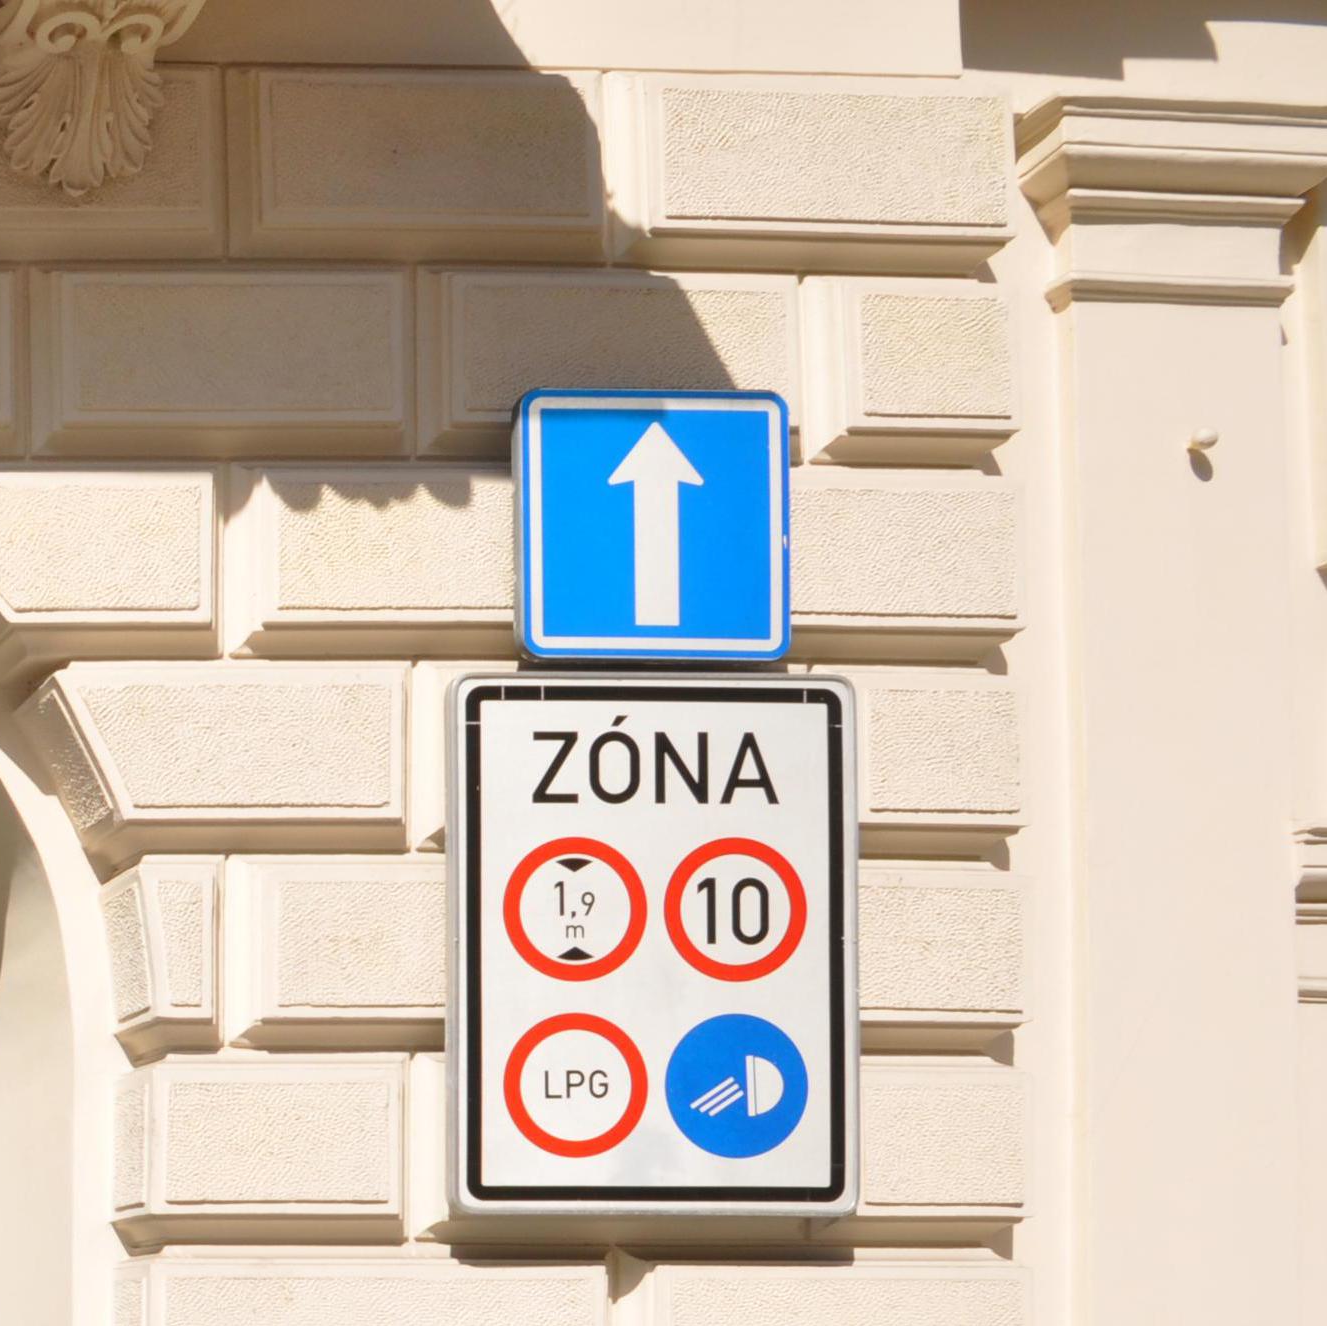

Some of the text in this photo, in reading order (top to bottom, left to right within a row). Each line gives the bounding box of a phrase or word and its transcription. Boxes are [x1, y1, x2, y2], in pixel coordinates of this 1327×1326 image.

[532, 715, 780, 804] ZÓNA
[553, 880, 596, 919] 1,9
[697, 876, 770, 945] 10
[565, 924, 585, 939] m
[544, 1069, 609, 1099] LPG
